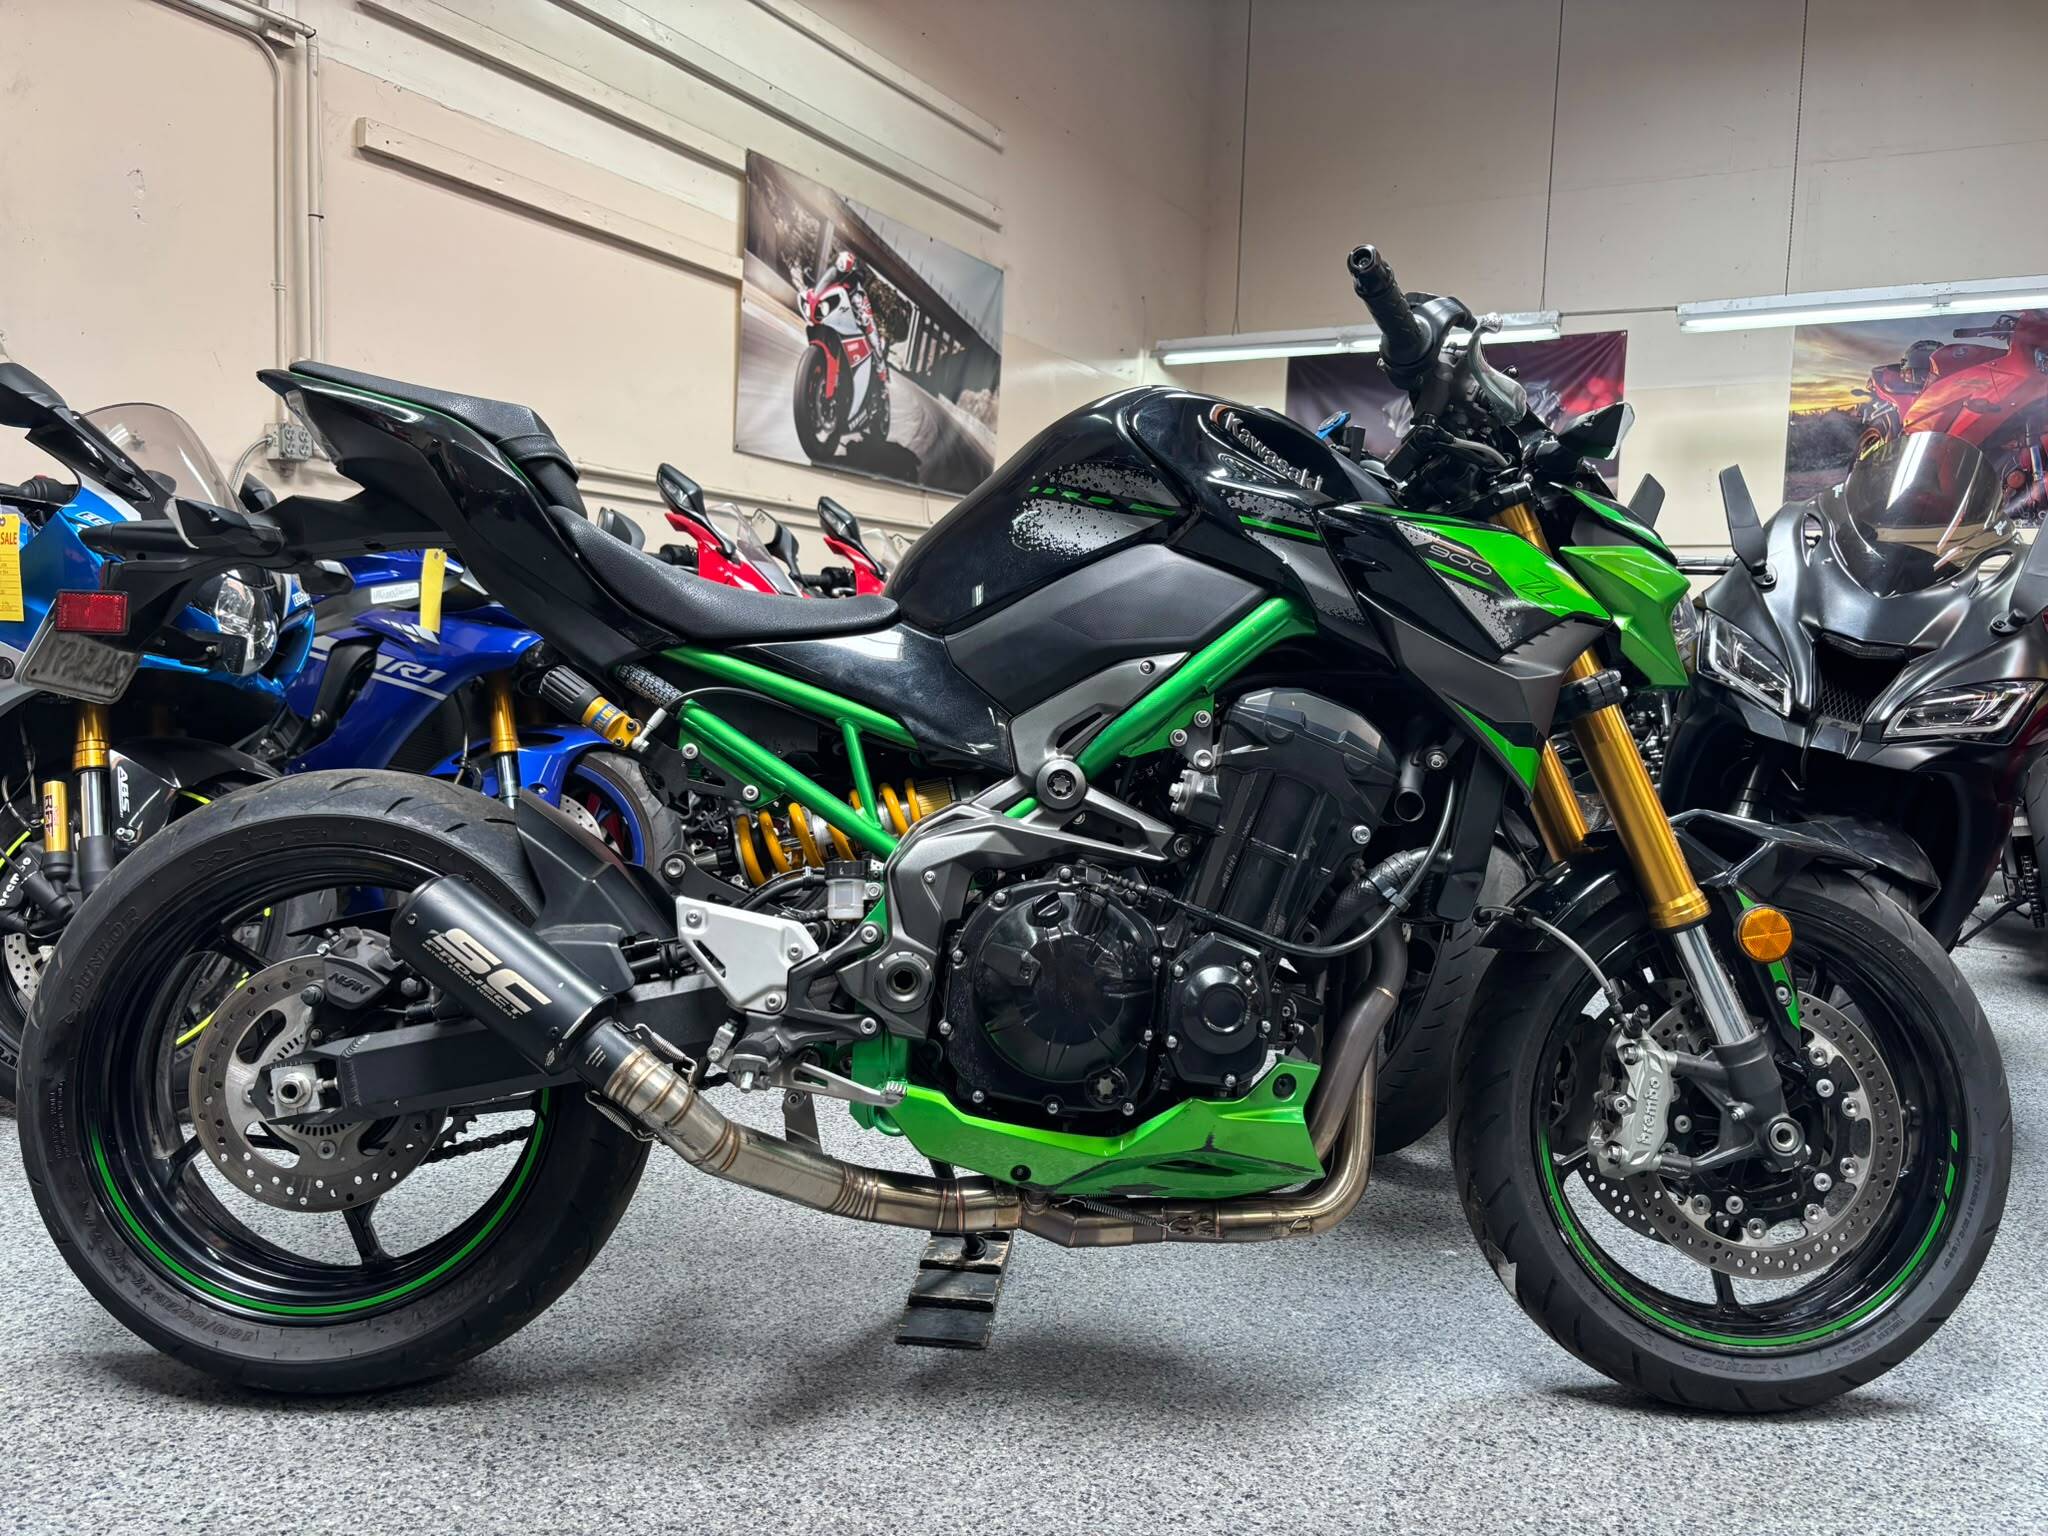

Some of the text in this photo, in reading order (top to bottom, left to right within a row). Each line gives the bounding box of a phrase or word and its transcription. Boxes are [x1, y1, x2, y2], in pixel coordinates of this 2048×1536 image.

[1225, 412, 1323, 490] Kawasaki
[0, 532, 17, 545] SALE
[1429, 544, 1492, 576] 900
[385, 661, 447, 684] R1
[117, 766, 130, 817] ABS
[424, 939, 524, 1016] PROJECT
[432, 927, 553, 1014] SC
[1636, 1076, 1660, 1146] brembo
